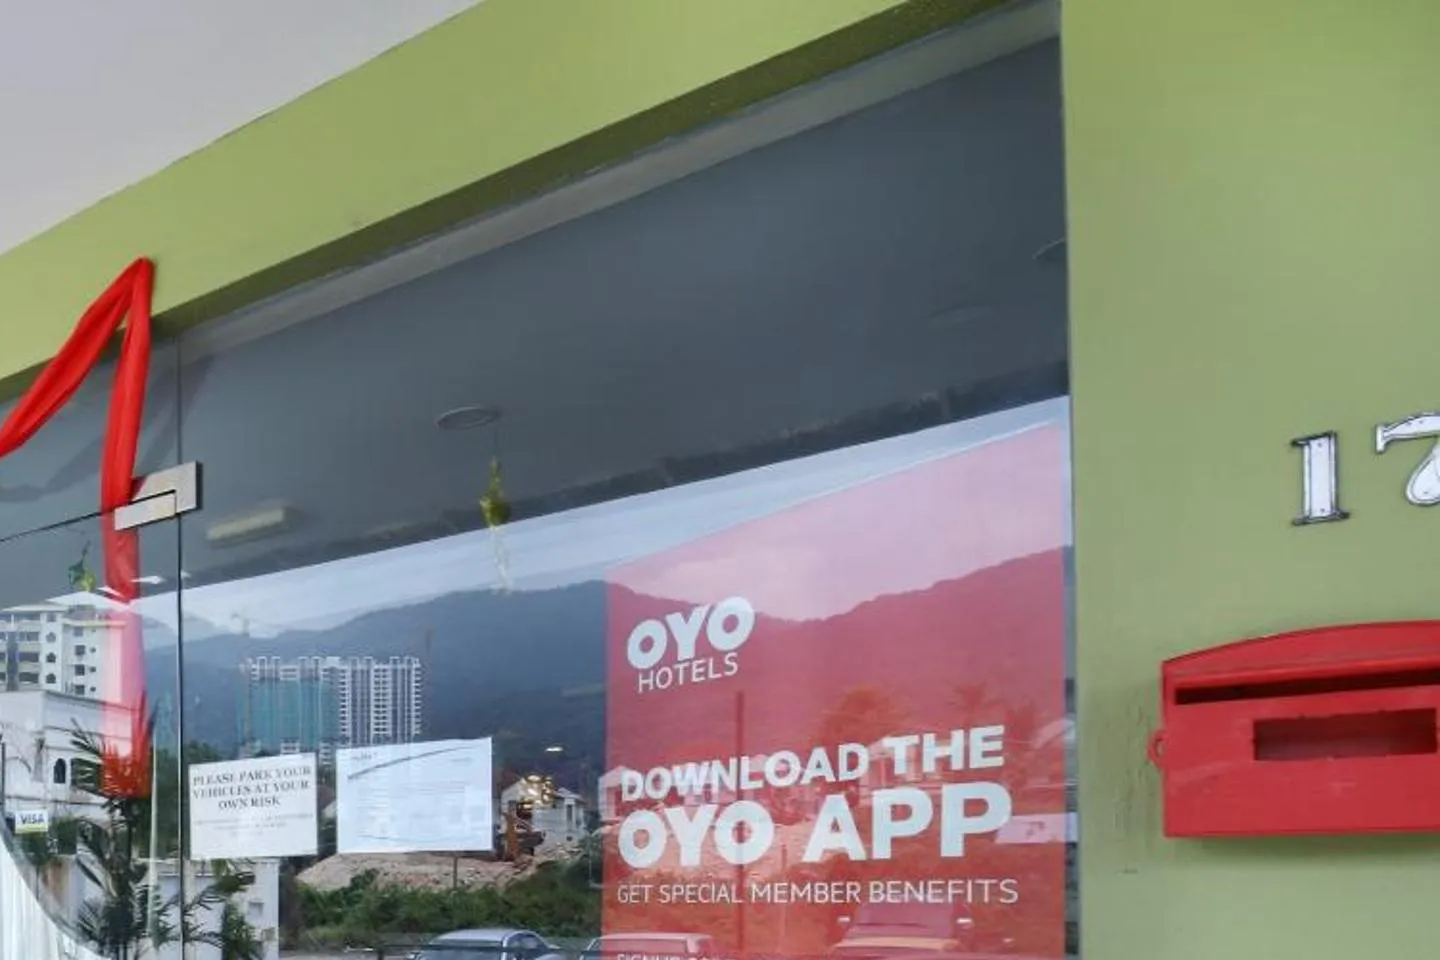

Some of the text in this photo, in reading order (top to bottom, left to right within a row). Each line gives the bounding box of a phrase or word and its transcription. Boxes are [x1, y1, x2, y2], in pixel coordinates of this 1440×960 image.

[626, 596, 756, 670] OYO
[637, 652, 739, 693] HOTELS
[193, 765, 311, 786] PLEASE PARK YOUR
[620, 725, 1005, 802] DOWNLOAD THE
[193, 780, 309, 799] VEHICLES AT YOUR
[219, 796, 281, 809] OWN RISK
[20, 813, 45, 825] VISA
[617, 780, 1013, 869] OYO APP
[617, 878, 1020, 904] GET SPECIAL MEMBER BENEFITS
